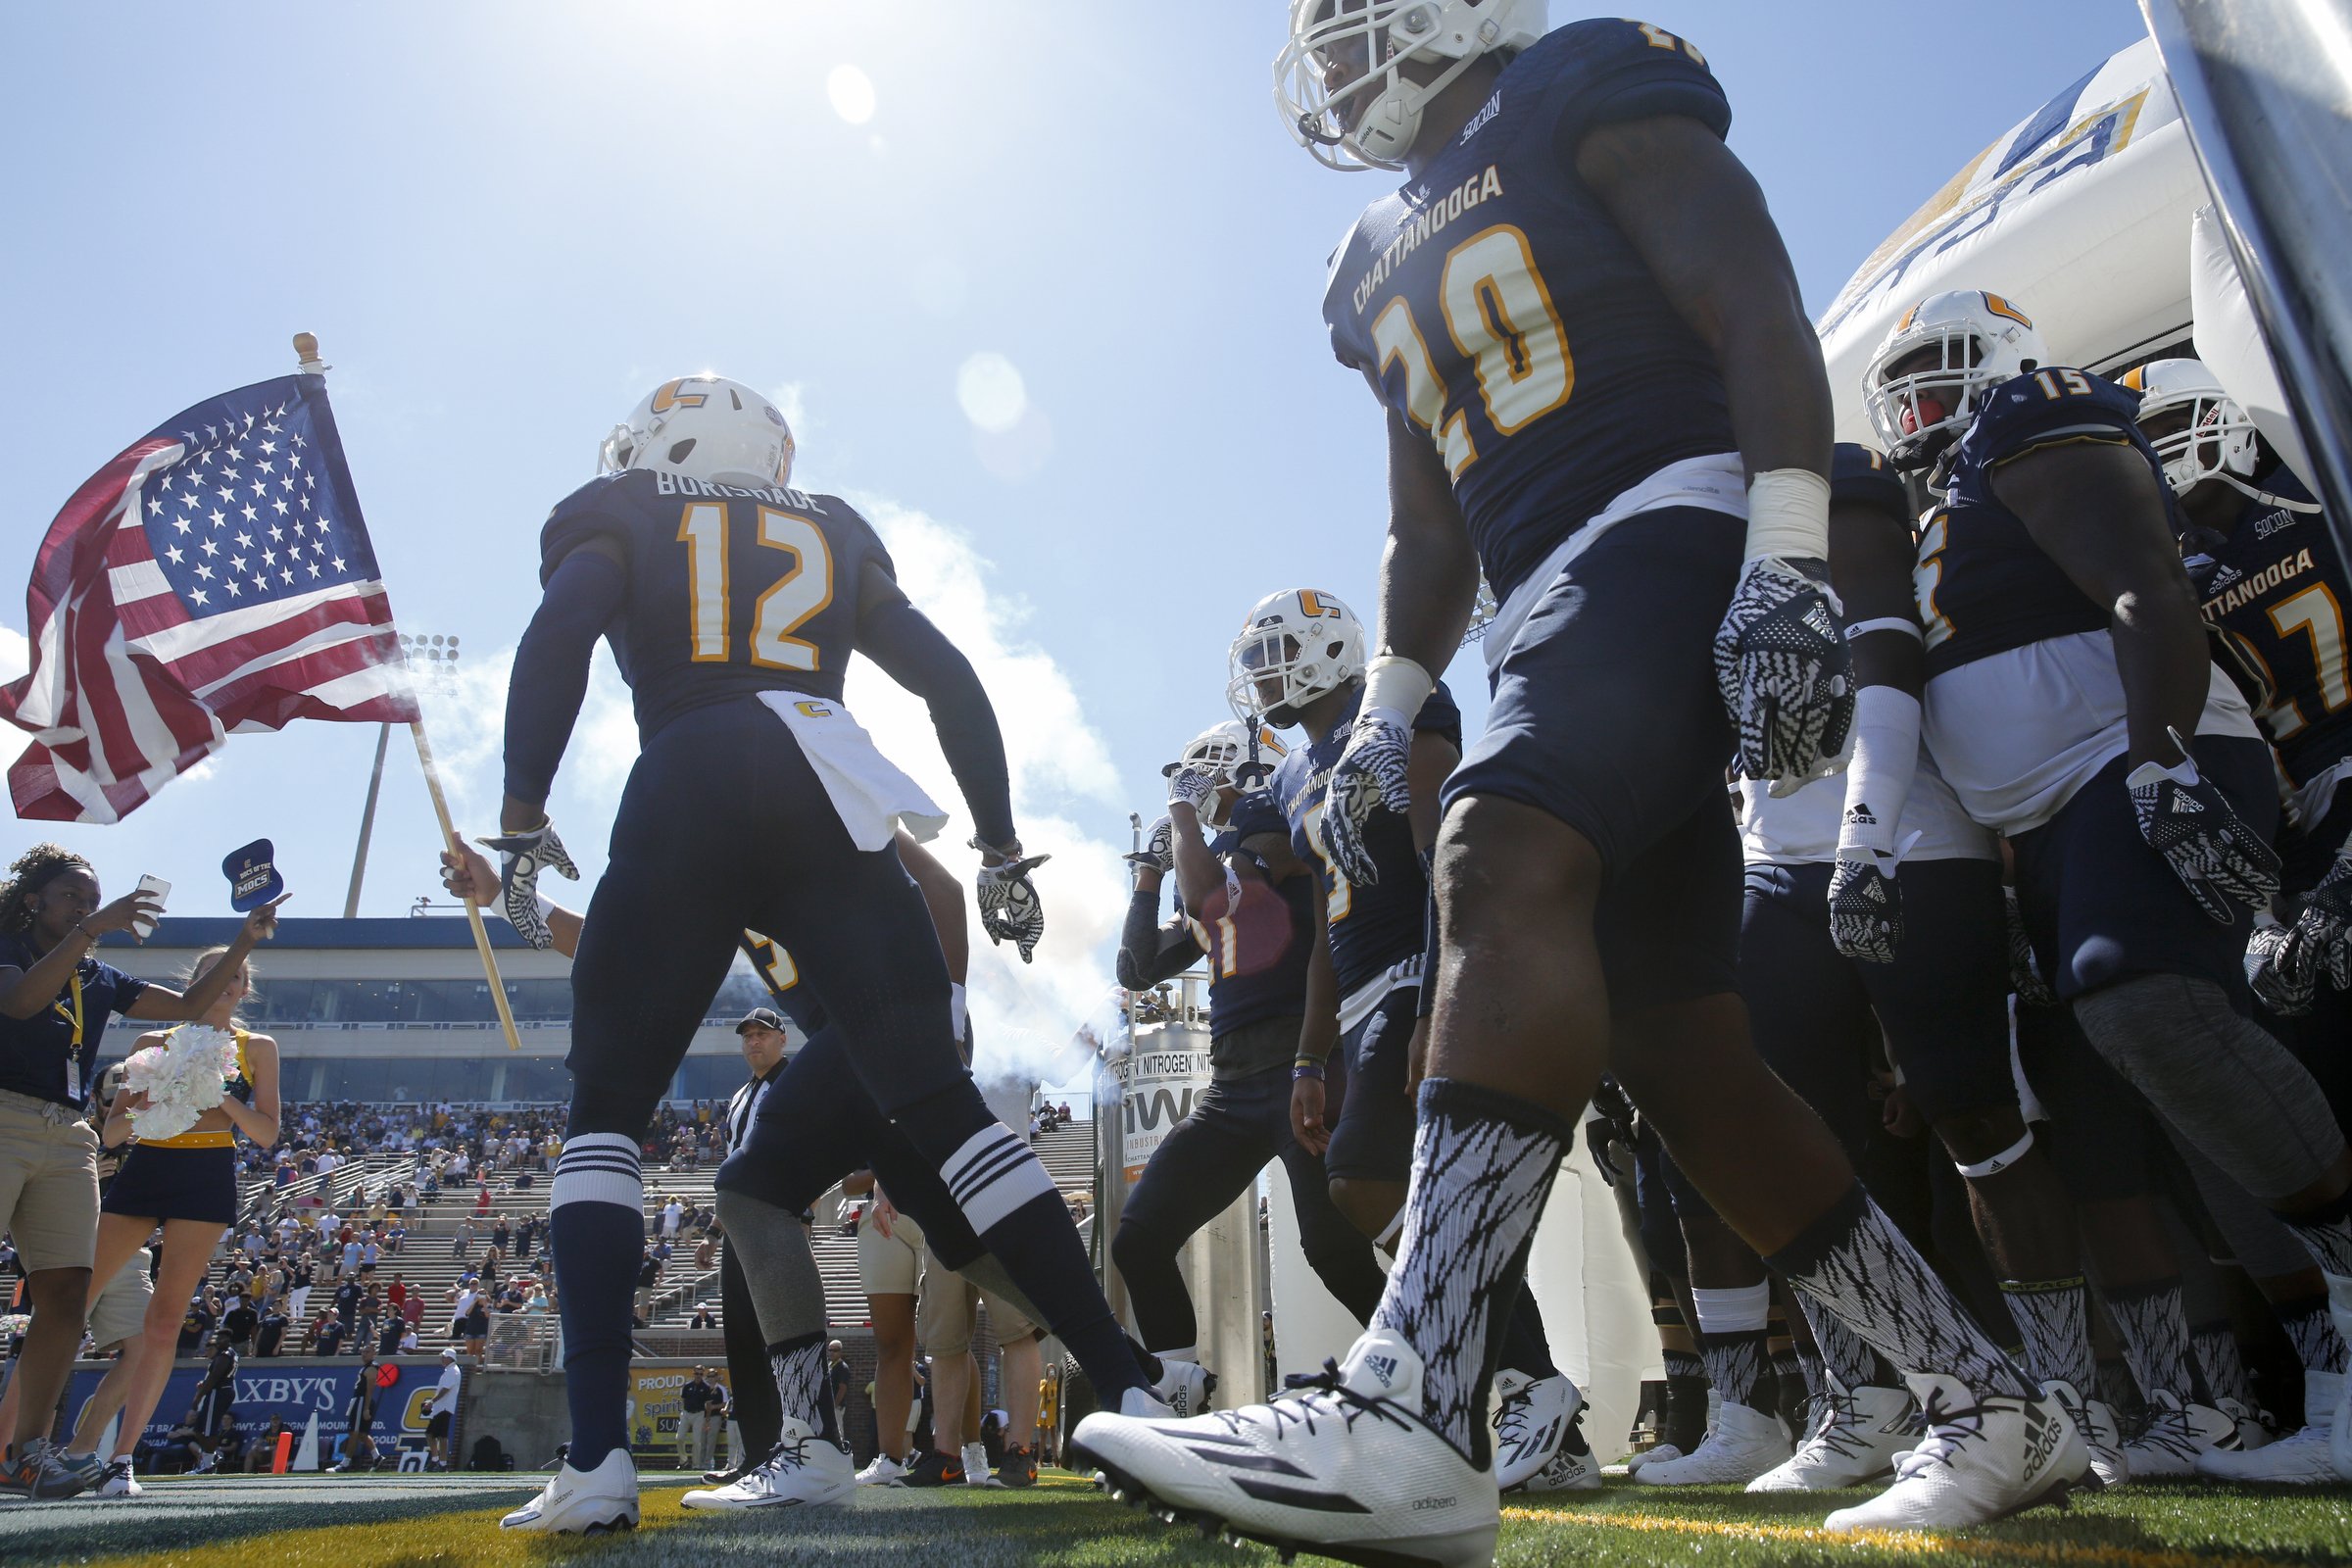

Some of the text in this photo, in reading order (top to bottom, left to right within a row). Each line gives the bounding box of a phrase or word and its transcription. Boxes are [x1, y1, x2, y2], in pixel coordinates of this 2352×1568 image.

[1460, 90, 1502, 146] SOCON
[1353, 164, 1503, 316] CHATTANOOGA
[1372, 223, 1575, 484] 20
[2034, 368, 2092, 400] 15
[2255, 508, 2296, 540] SOCON
[676, 502, 833, 672] 12
[2201, 548, 2315, 621] TTANOOGA
[2209, 568, 2242, 594] adidas
[1813, 599, 1838, 645] adidas
[2173, 788, 2204, 812] adidas
[1842, 812, 1877, 826] didas
[237, 873, 269, 896] MOCS
[1871, 875, 1886, 904] adidas
[1143, 1054, 1193, 1076] NITROGEN
[1127, 1153, 1152, 1163] CHATTAN
[2006, 1278, 2080, 1291] IMPACT
[639, 1375, 685, 1391] PROUD
[1364, 1355, 1392, 1389] adidas
[232, 1377, 337, 1411] XBY'S
[1177, 1384, 1187, 1418] didas
[2023, 1416, 2062, 1482] adidas
[1548, 1464, 1586, 1487] adidas
[555, 1489, 574, 1506] adizero
[1412, 1495, 1457, 1511] adizero
